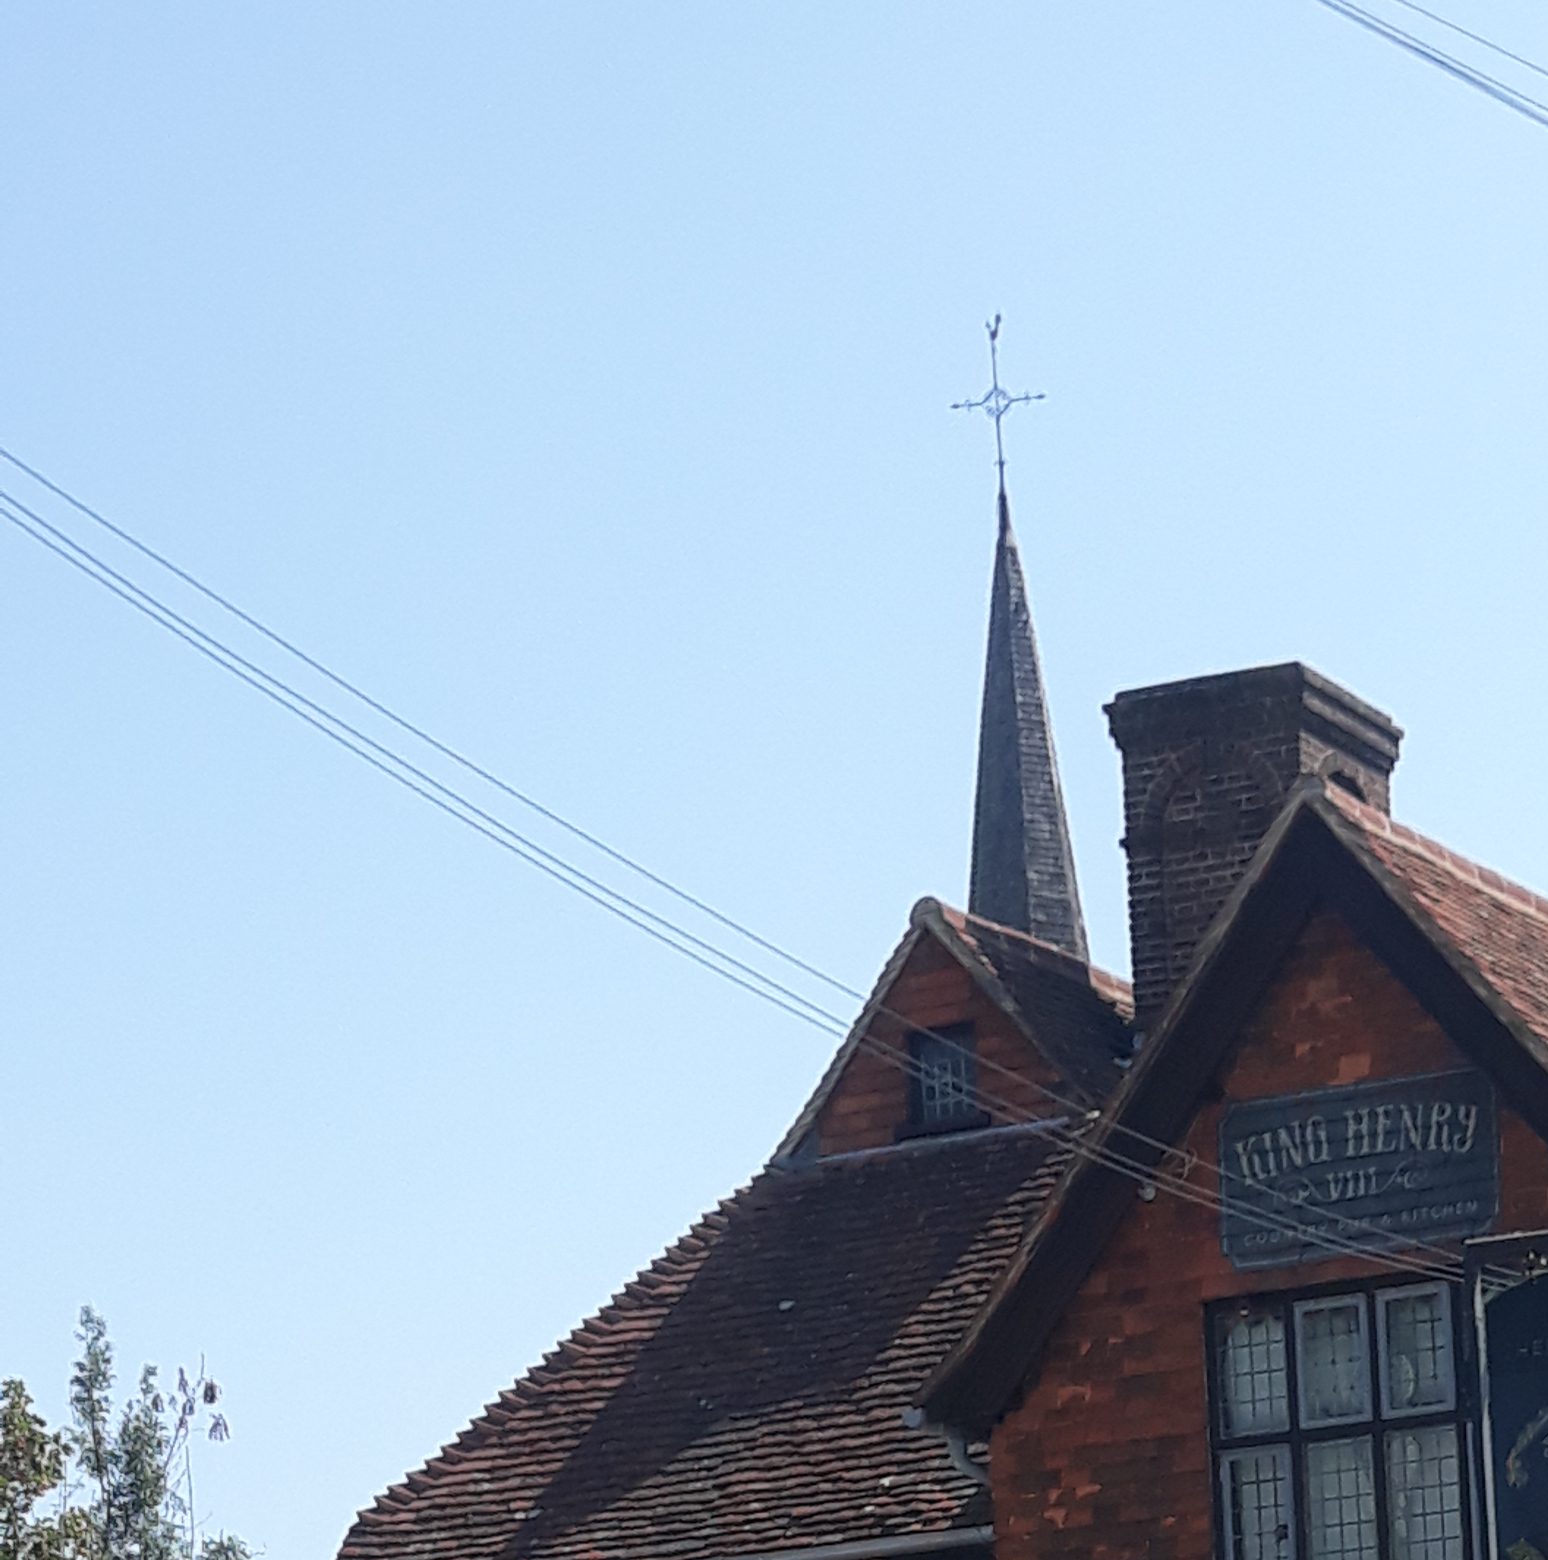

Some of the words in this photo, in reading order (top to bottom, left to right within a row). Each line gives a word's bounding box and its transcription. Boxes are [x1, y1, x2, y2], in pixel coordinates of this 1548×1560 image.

[1235, 1114, 1332, 1185] KING
[1344, 1102, 1478, 1157] HENRY
[1325, 1166, 1379, 1201] VIII
[1400, 1199, 1479, 1223] KITCHEN
